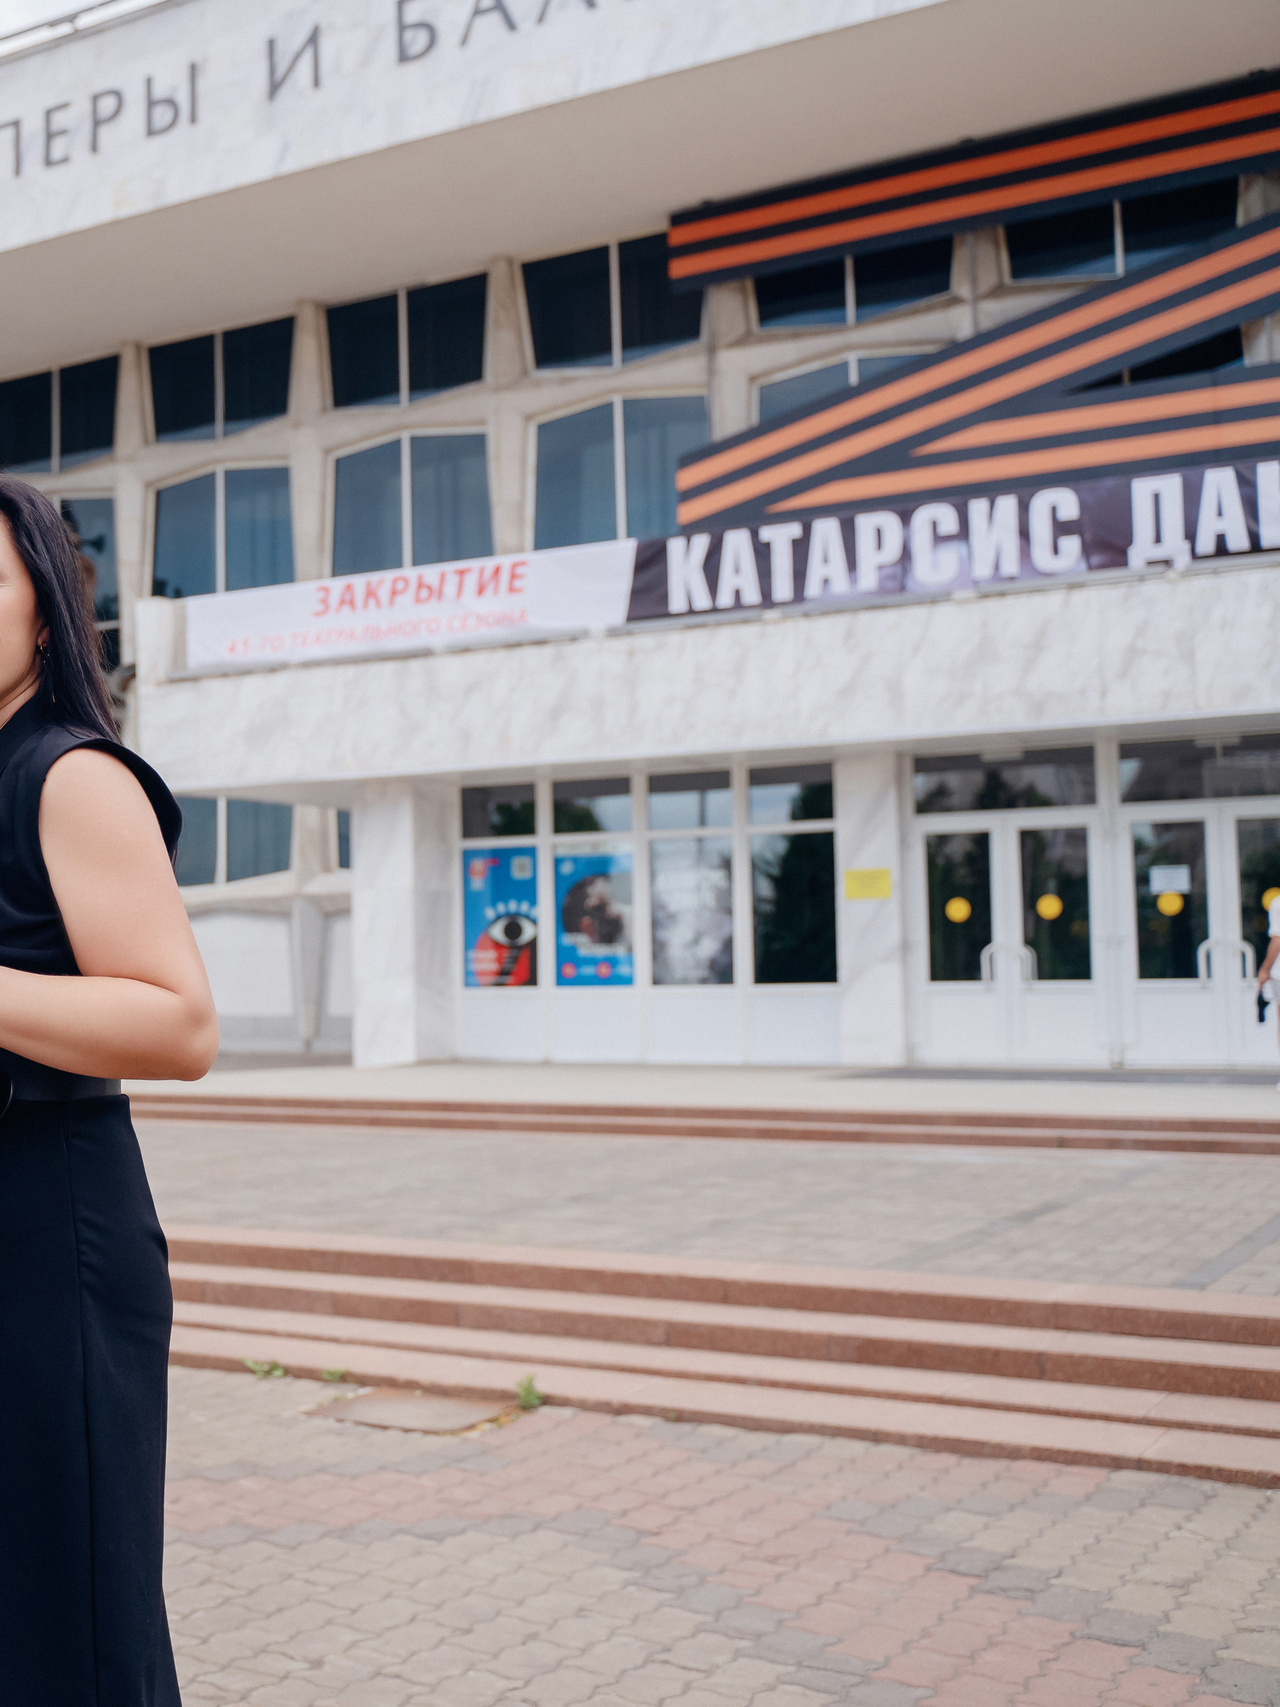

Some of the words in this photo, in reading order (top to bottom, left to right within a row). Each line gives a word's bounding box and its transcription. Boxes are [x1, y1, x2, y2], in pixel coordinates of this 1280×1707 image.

[267, 24, 321, 101] И
[396, 0, 597, 64] БА
[312, 560, 529, 618] ЗАКРЫТИЕ
[665, 487, 1084, 615] КАТАРСИС
